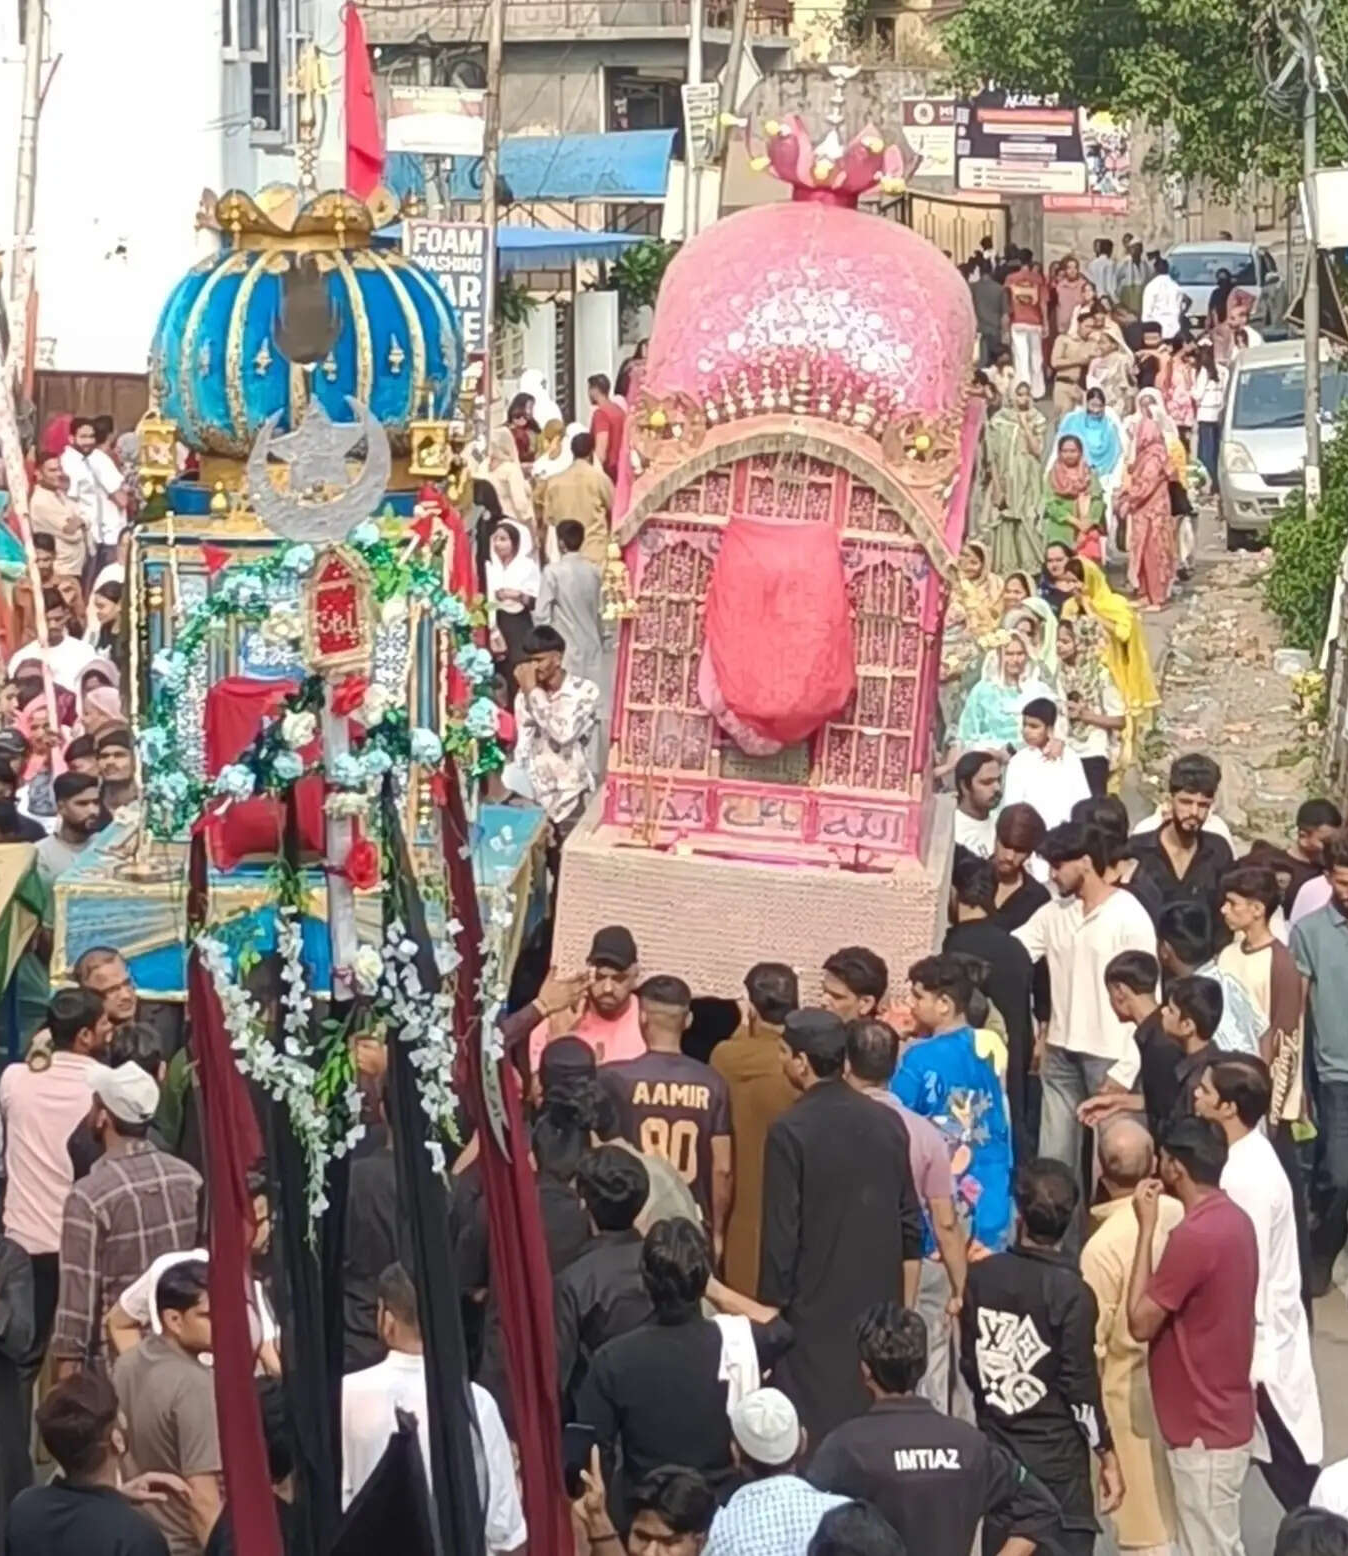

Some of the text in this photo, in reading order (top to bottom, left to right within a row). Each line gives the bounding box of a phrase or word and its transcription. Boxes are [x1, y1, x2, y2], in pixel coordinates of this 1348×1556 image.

[413, 227, 483, 255] FOAM
[411, 254, 483, 273] WASHING
[438, 274, 482, 308] AR
[632, 1081, 710, 1110] AAMIR
[894, 1449, 961, 1471] IMTIAZ
